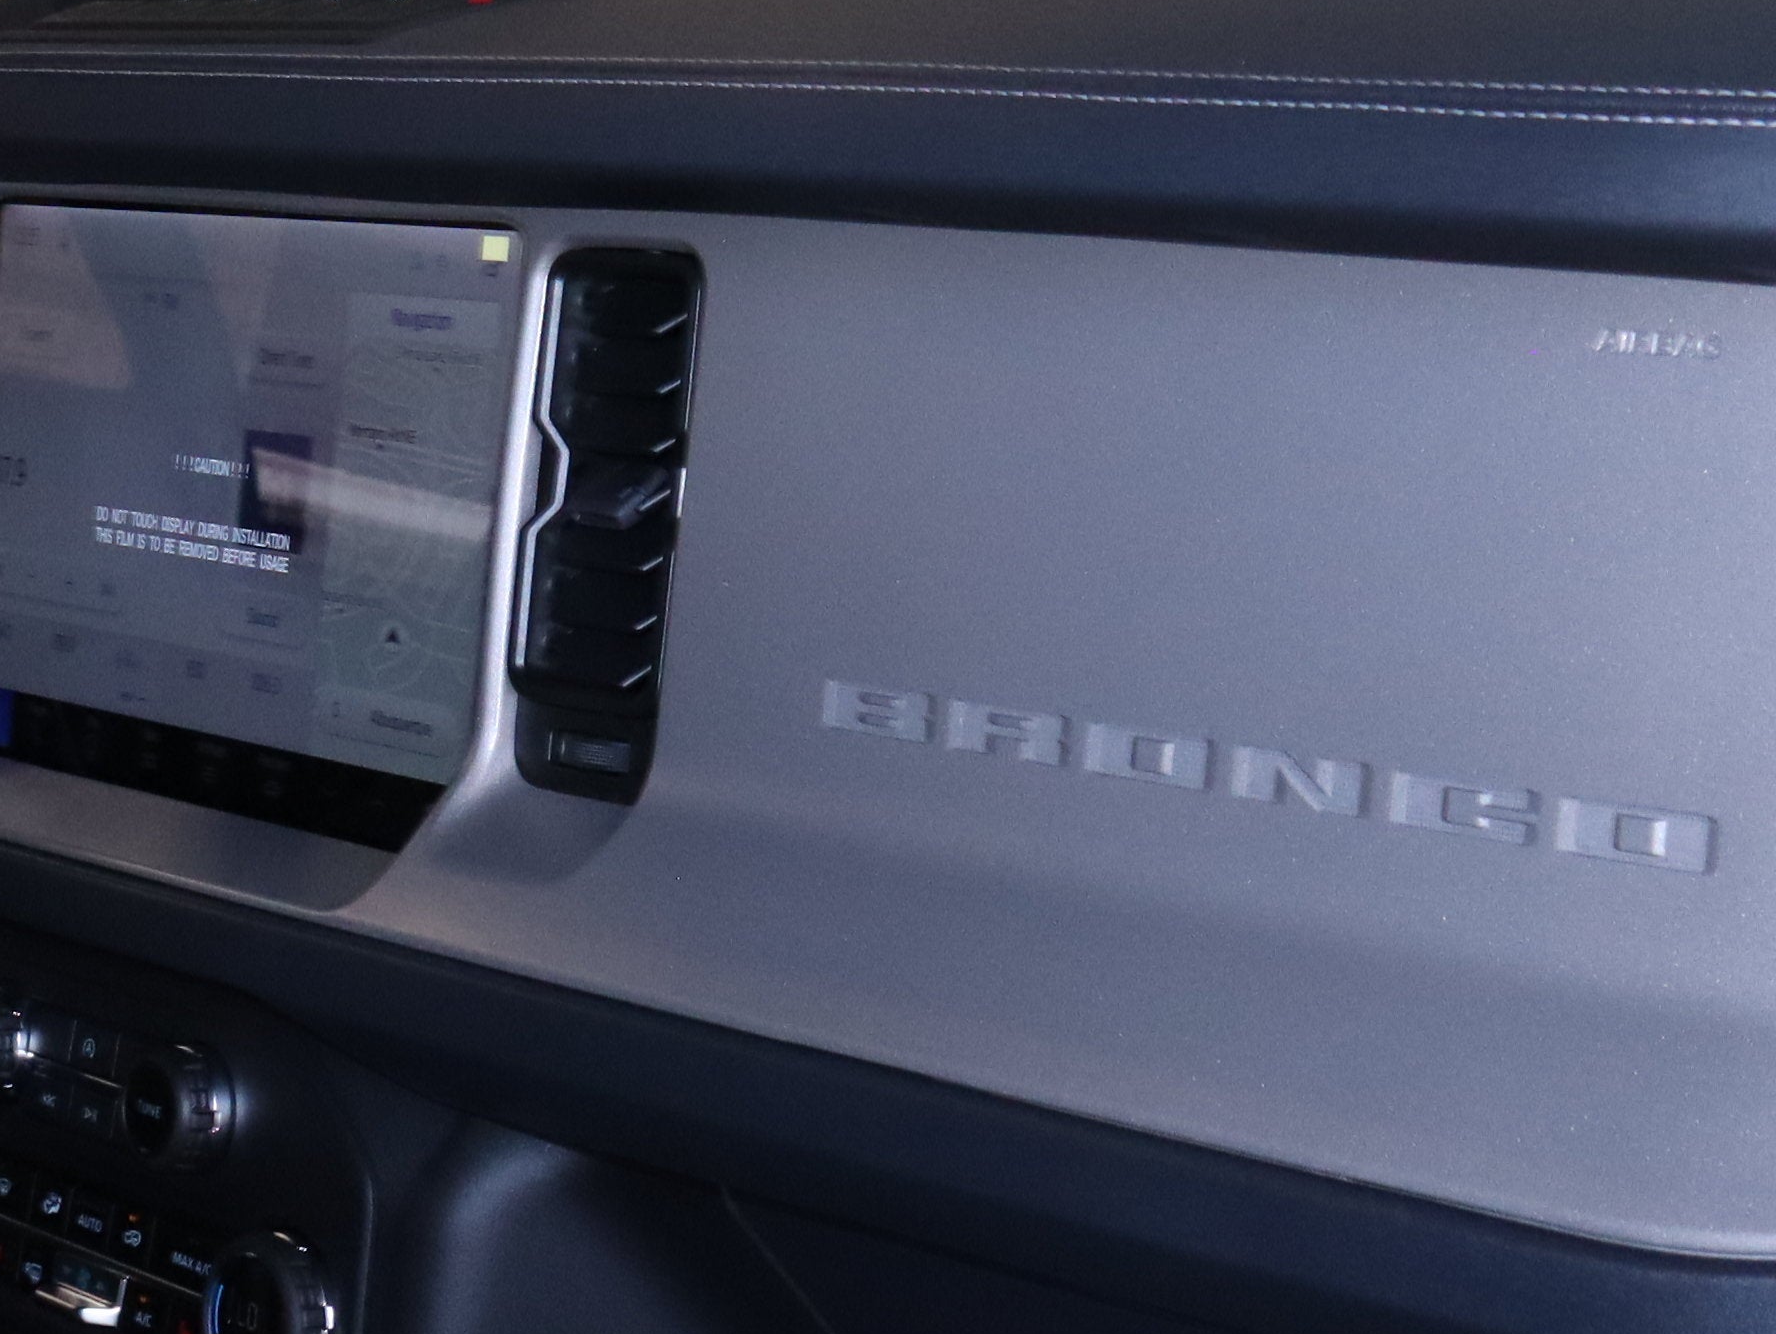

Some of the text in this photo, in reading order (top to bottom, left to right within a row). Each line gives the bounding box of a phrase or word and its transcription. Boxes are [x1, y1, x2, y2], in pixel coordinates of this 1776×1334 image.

[96, 506, 290, 551] DO NOT TOUCH DISPLAY DURING INSTALLATION
[96, 527, 112, 543] THIS
[116, 530, 134, 547] FILM
[138, 534, 145, 549] IS
[149, 535, 160, 551] TO
[164, 539, 176, 554] BE
[179, 541, 219, 561] REMOVED
[222, 548, 257, 567] BEFORE
[823, 677, 1718, 875] BRONCO
[78, 1213, 104, 1235] AUTO
[171, 1251, 213, 1276] MAX A/C
[136, 1311, 152, 1328] A/C
